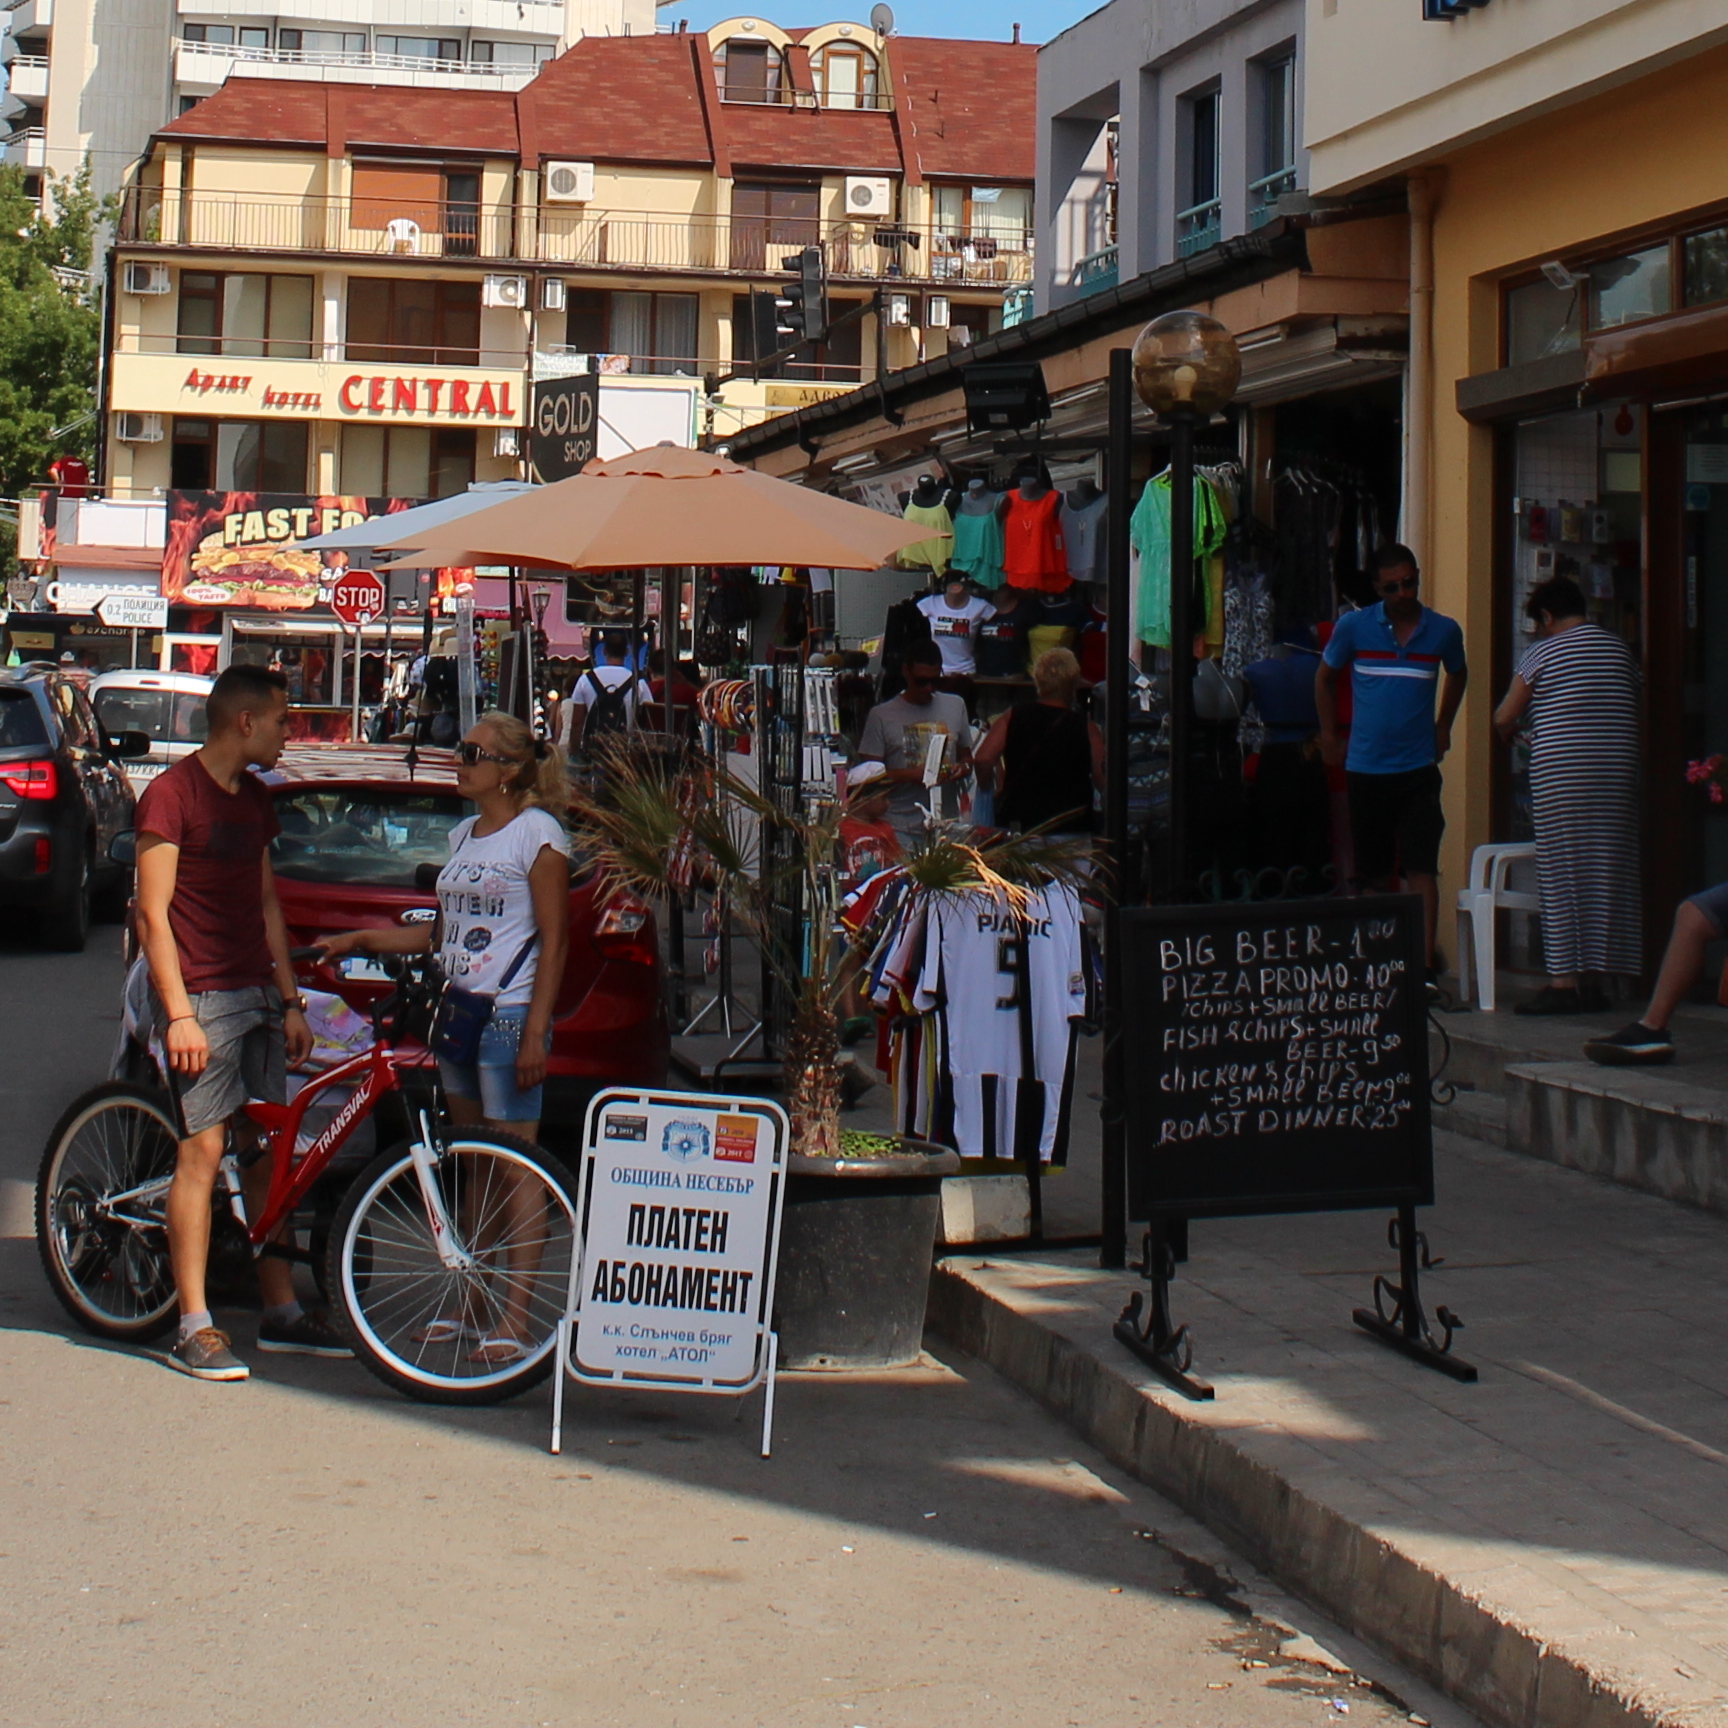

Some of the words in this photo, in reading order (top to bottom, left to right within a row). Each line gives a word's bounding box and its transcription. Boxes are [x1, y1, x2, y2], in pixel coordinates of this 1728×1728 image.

[341, 375, 516, 417] CENTRAL
[538, 392, 592, 437] GOLD
[563, 440, 592, 463] SHOP
[224, 508, 314, 544] FAST
[106, 605, 121, 616] 0.2
[123, 598, 165, 612] ПОЛИЦИЯ
[336, 587, 380, 607] STOP
[122, 611, 153, 624] POLICE
[1160, 936, 1215, 971] BIG
[1236, 925, 1324, 965] BEER
[1161, 971, 1252, 1003] PIZZA
[1163, 1024, 1218, 1052] FISH
[315, 1087, 370, 1154] TRANSVAL
[1159, 1109, 1248, 1144] ROAST
[1257, 1104, 1365, 1133] DINNER
[610, 1166, 682, 1189] ОБЩИНА
[686, 1173, 755, 1195] НЕСЕБЪР
[626, 1202, 729, 1254] ПЛАТЕН
[590, 1258, 754, 1315] АБОНАМЕНТ
[630, 1323, 696, 1343] Слънчев
[699, 1329, 734, 1347] бряг
[615, 1344, 657, 1358] хотел
